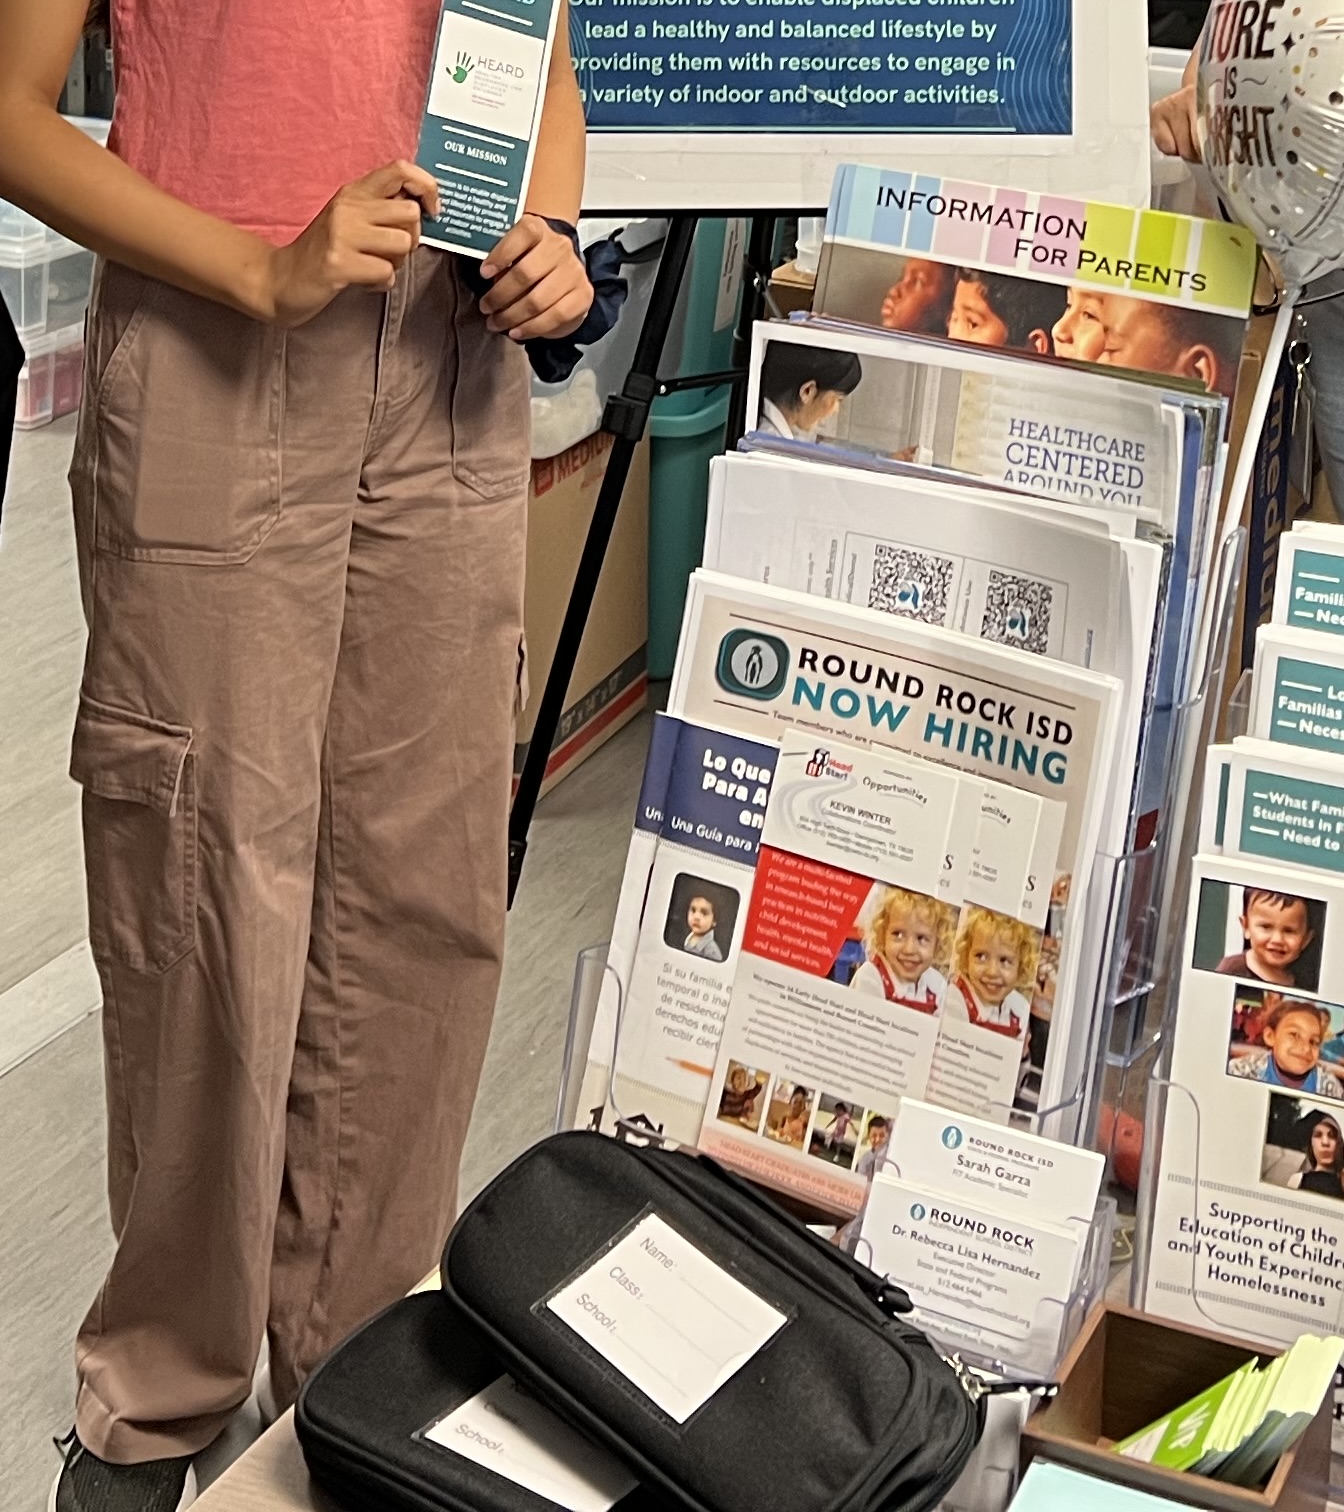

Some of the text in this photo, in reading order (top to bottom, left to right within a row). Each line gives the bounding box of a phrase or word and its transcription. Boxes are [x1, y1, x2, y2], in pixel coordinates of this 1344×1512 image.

[585, 19, 998, 43] lead a healthy and balanced lifestyle by
[477, 55, 525, 79] HEARD
[668, 53, 723, 72] them
[727, 53, 774, 72] with
[778, 55, 881, 73] resources
[886, 53, 910, 72] to
[913, 55, 991, 77] engage
[995, 52, 1016, 72] in
[591, 85, 665, 108] variety
[668, 85, 692, 104] of
[695, 85, 764, 104] indoor
[768, 85, 808, 105] and
[812, 85, 899, 106] outdoor
[902, 84, 1006, 105] activities.
[444, 139, 508, 166] OUR MISSION
[875, 185, 1088, 242] INFORMATION
[1007, 417, 1146, 463] HEALTHCARE
[1005, 440, 1145, 490] CENTERED
[798, 646, 1075, 748] ROUND ROCK ISD
[1277, 695, 1344, 721] Familias
[790, 676, 1069, 787] NOW HIRING
[702, 749, 772, 785] Lo Que
[702, 771, 749, 802] Para
[861, 775, 929, 806] Opportunities
[1268, 791, 1309, 812] What
[829, 799, 893, 826] KEVIN WINTER
[1252, 805, 1316, 829] Students
[1317, 817, 1333, 832] in
[671, 816, 694, 834] Una
[725, 834, 753, 852] para
[1282, 829, 1322, 848] Need
[1323, 836, 1341, 851] to
[968, 1136, 1005, 1154] ROUND
[1007, 1148, 1035, 1164] ROCK
[956, 1153, 991, 1176] Sarah
[994, 1165, 1032, 1188] Garza
[929, 1207, 987, 1235] ROUND
[990, 1226, 1035, 1251] ROCK
[1178, 1216, 1264, 1250] Education
[1267, 1238, 1288, 1256] of
[1208, 1201, 1338, 1247] Supporting the
[640, 1236, 678, 1272] Name:
[891, 1223, 908, 1240] Dr.
[909, 1229, 955, 1254] Rebecca
[956, 1244, 979, 1261] Lisa
[981, 1252, 1042, 1281] Hernandez
[1167, 1239, 1202, 1256] and
[1205, 1242, 1255, 1270] Youth
[608, 1264, 645, 1301] Class:
[1207, 1263, 1327, 1308] Homelessness
[576, 1292, 618, 1335] School:
[454, 1422, 506, 1455] School:
